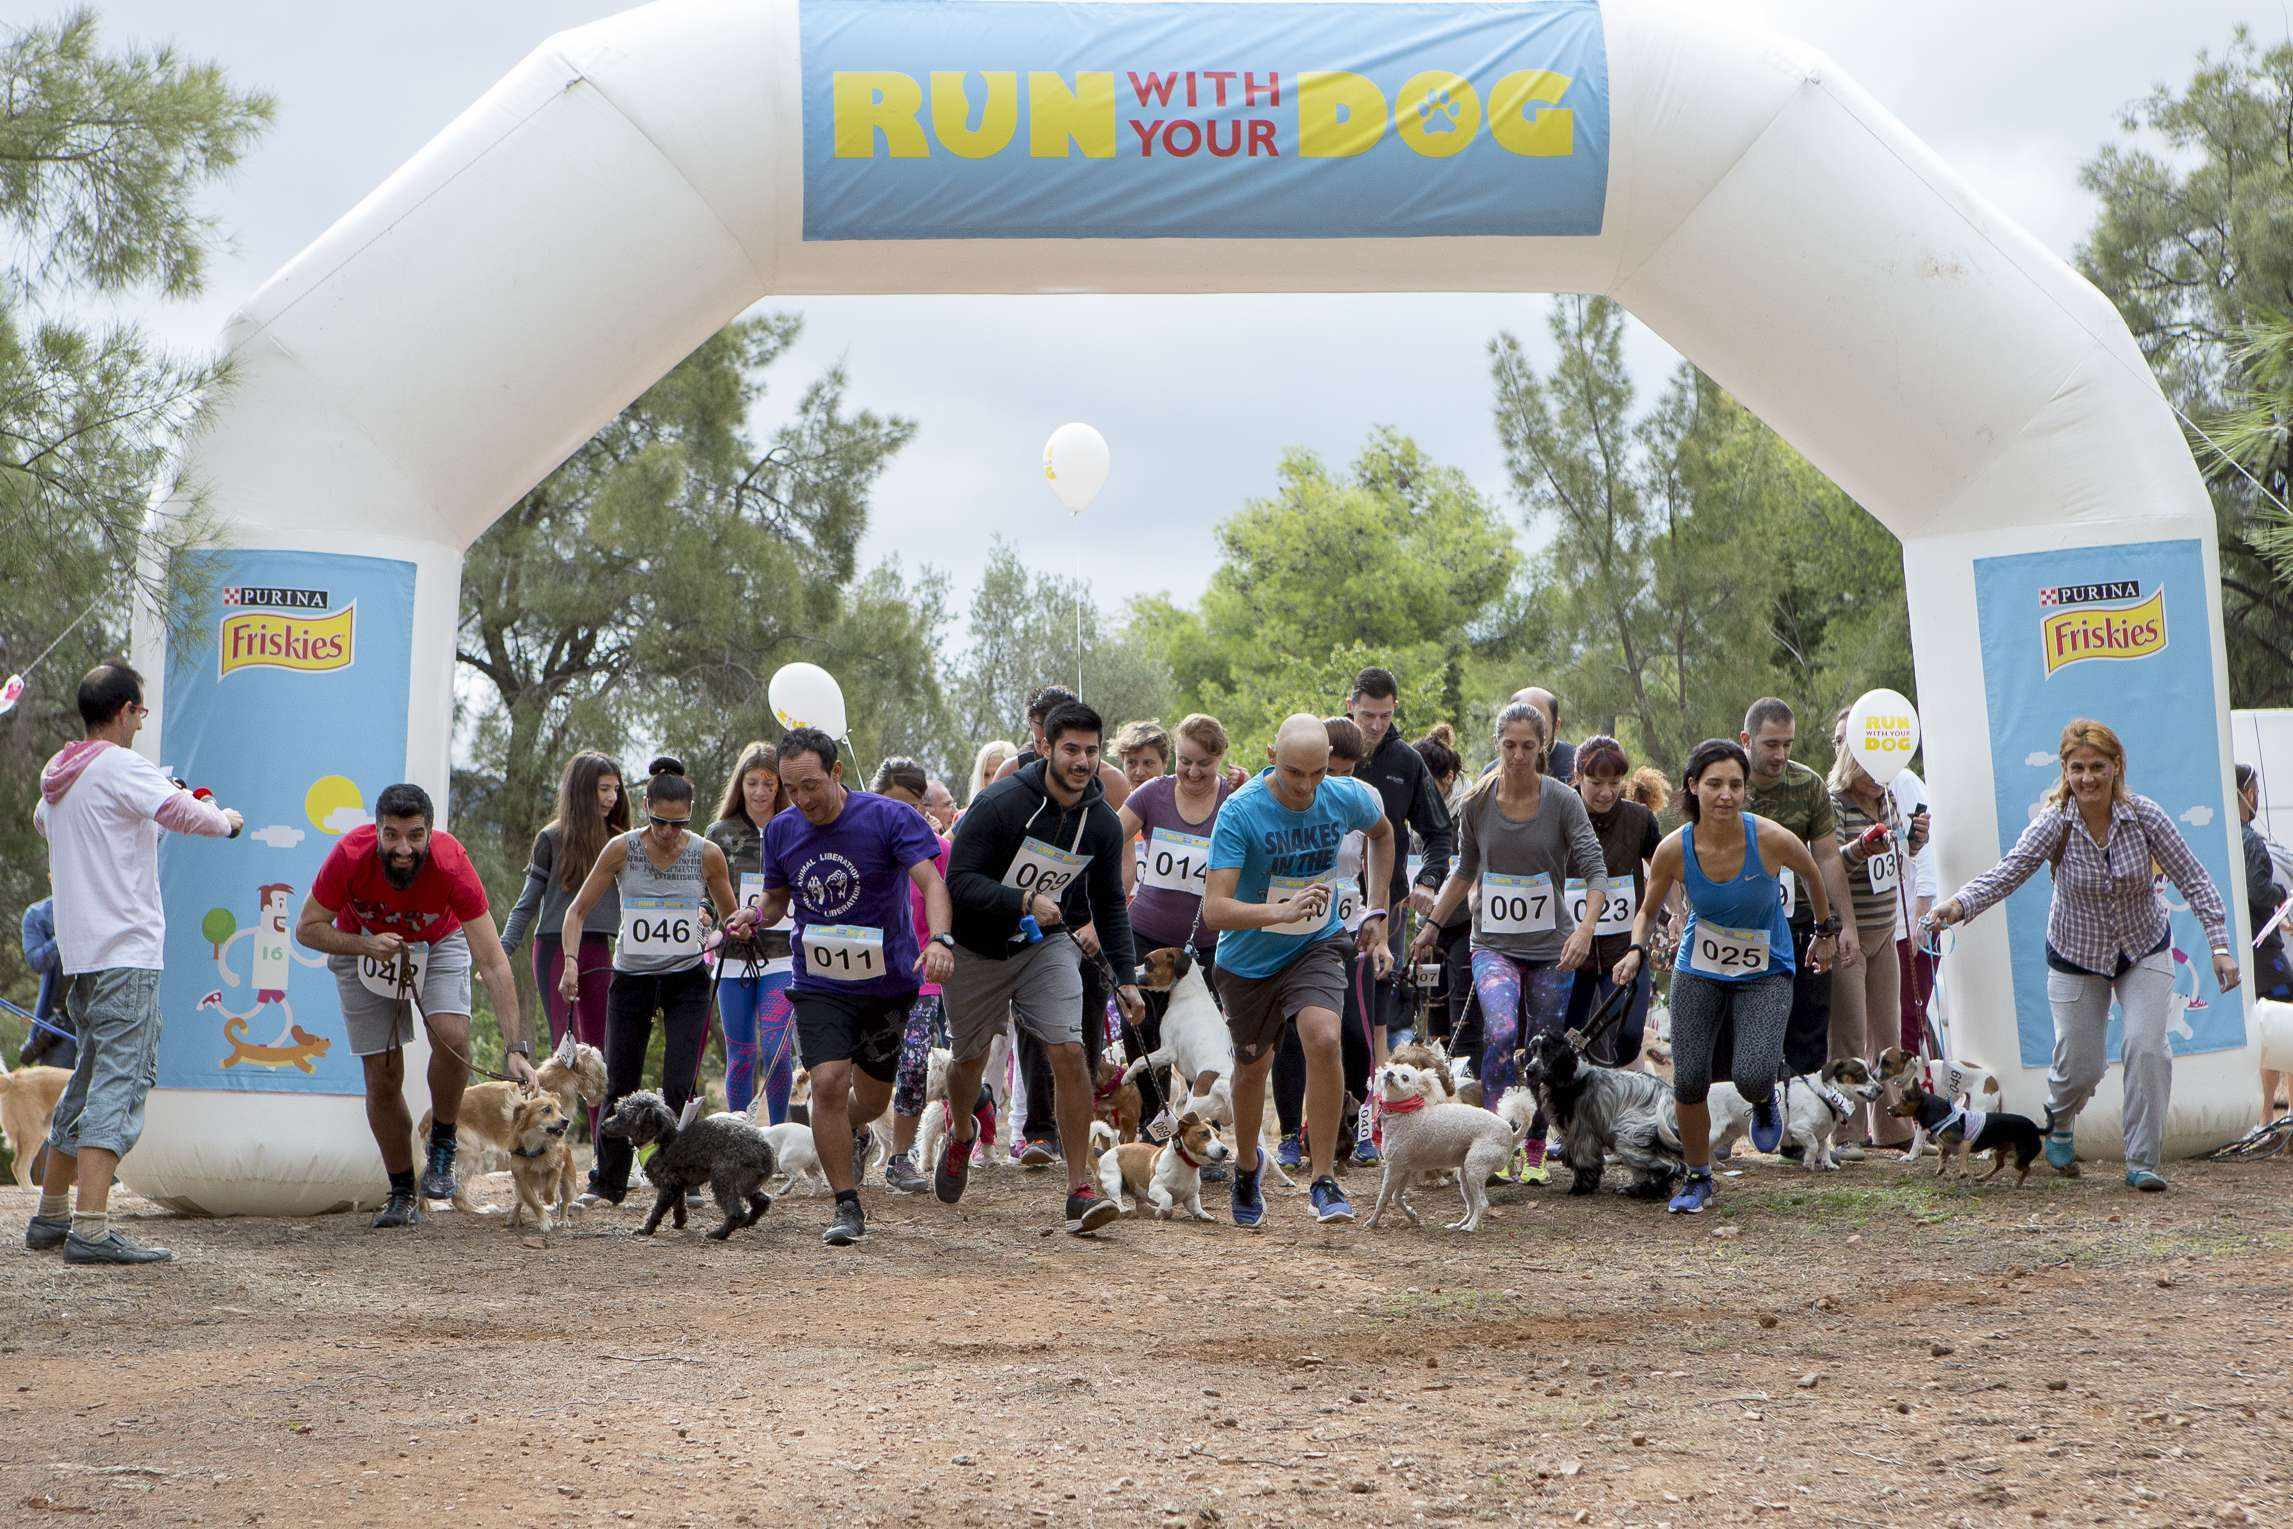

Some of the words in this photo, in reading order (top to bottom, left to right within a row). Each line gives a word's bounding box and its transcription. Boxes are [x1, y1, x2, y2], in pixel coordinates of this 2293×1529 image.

[1127, 71, 1280, 107] WITH
[833, 71, 1116, 158] RUN
[1297, 69, 1574, 158] DOG
[1129, 119, 1279, 157] YOUR
[244, 589, 324, 607] PURINA
[2062, 582, 2136, 602] PURINA
[232, 624, 343, 660] Friskies
[2055, 618, 2158, 657] Friskies
[1865, 715, 1911, 729] RUN
[1865, 737, 1912, 751] DOG
[1265, 822, 1340, 855] SNAKES
[797, 858, 817, 887] ANIMAL
[1016, 862, 1071, 894] 069
[1873, 854, 1896, 881] 03
[1491, 895, 1547, 921] 007
[633, 919, 690, 943] 046
[262, 946, 283, 961] 16
[814, 946, 871, 970] 011
[1703, 940, 1761, 968] 025
[363, 956, 419, 986] 04
[1153, 1121, 1171, 1138] 069
